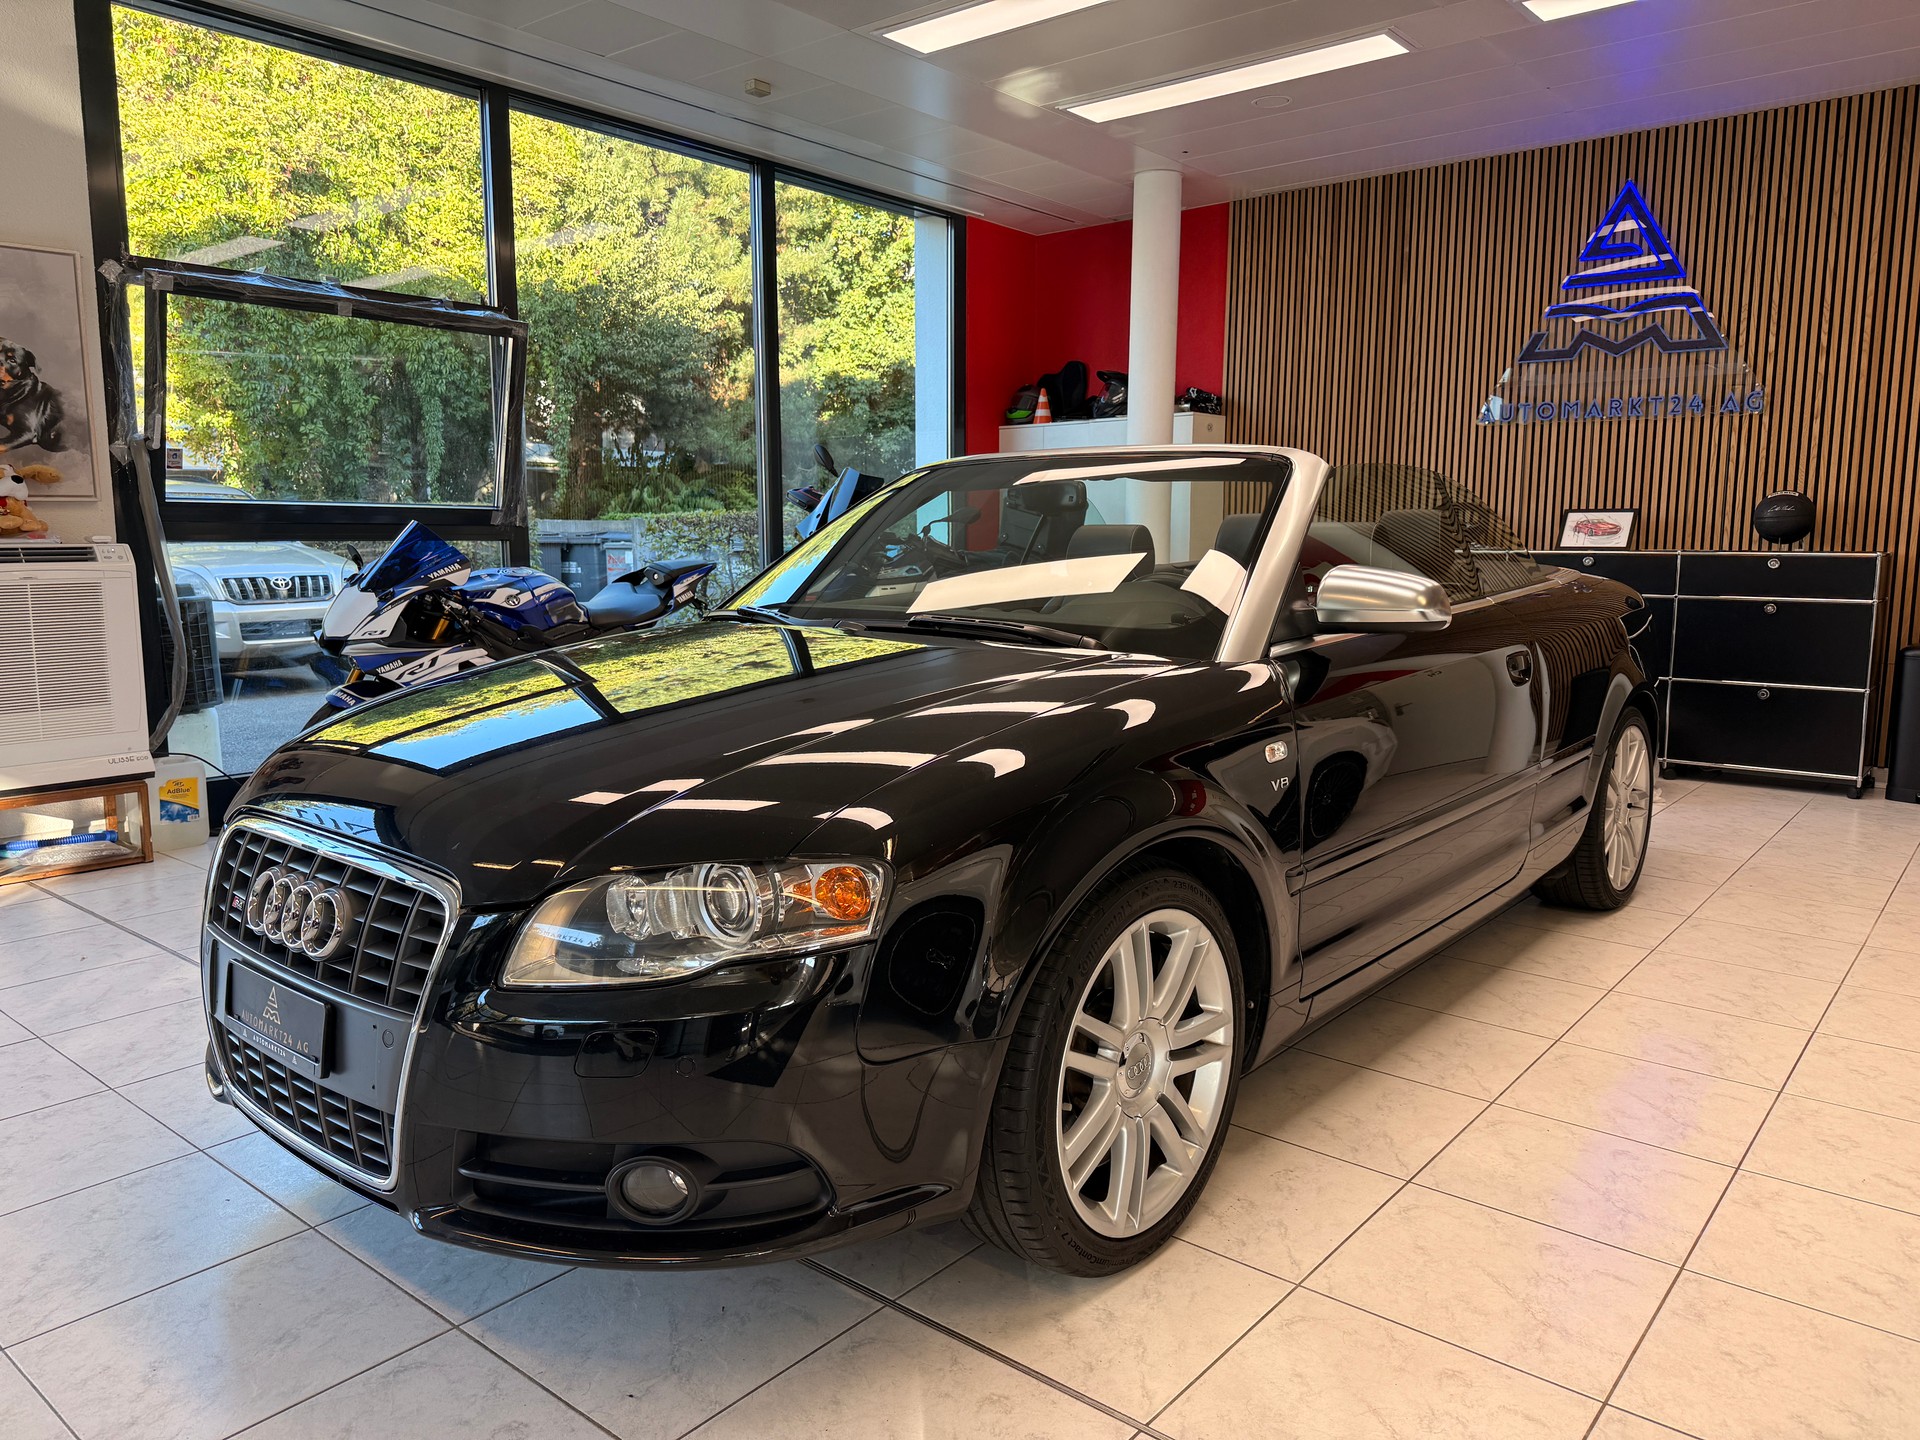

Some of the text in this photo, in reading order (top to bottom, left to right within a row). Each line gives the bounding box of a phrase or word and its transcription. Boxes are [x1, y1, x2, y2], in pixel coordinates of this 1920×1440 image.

[1479, 390, 1766, 425] AUTOMARKT24 AG
[428, 562, 462, 580] YAMAHA
[375, 659, 404, 674] YAMAHA
[395, 655, 441, 681] R1
[108, 755, 135, 765] ULISSE
[1271, 777, 1290, 792] V8
[241, 1008, 309, 1054] AUTOMARKT24 AG
[252, 1034, 287, 1058] AUTOMARKT24
